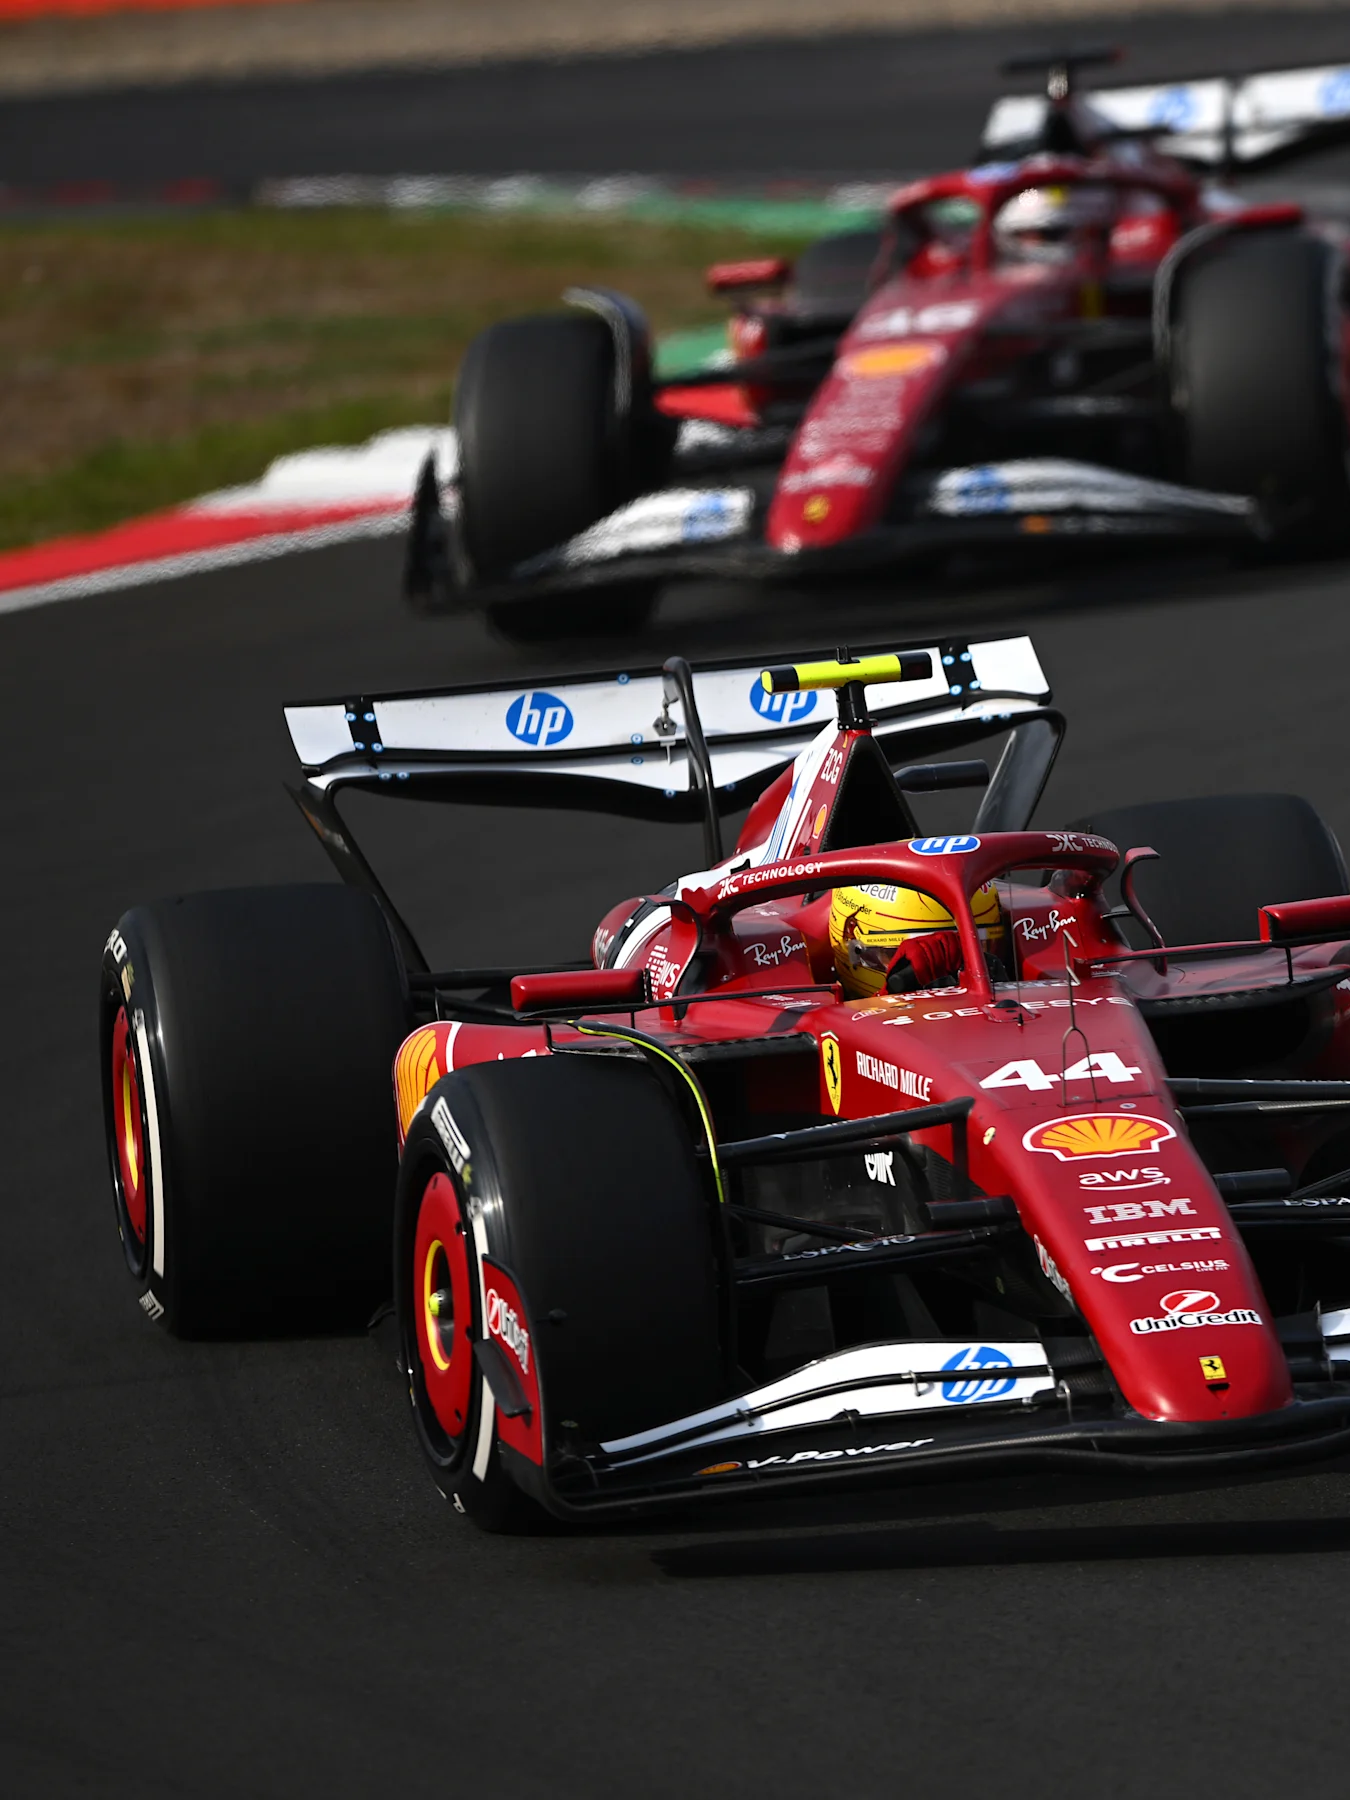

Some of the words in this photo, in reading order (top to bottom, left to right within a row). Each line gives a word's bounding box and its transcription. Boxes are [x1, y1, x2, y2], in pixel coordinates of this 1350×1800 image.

[509, 691, 572, 746] hp
[914, 836, 975, 855] hp
[1045, 834, 1084, 852] DXC
[742, 861, 824, 886] TECHNOLOGY
[1012, 909, 1077, 941] Ray-Ban
[743, 935, 807, 966] Ray-Ban
[922, 996, 1135, 1022] GEESYS
[856, 1050, 898, 1091] RICHARD
[899, 1068, 933, 1102] MILLE
[979, 1052, 1142, 1091] 44
[1078, 1166, 1166, 1187] aws
[1083, 1198, 1198, 1225] IBM
[1084, 1227, 1223, 1252] PIRELLI
[1141, 1259, 1229, 1274] CELSIUS
[1132, 1310, 1262, 1333] UniCredit
[943, 1346, 1014, 1404] hp
[747, 1437, 935, 1469] V-Power
